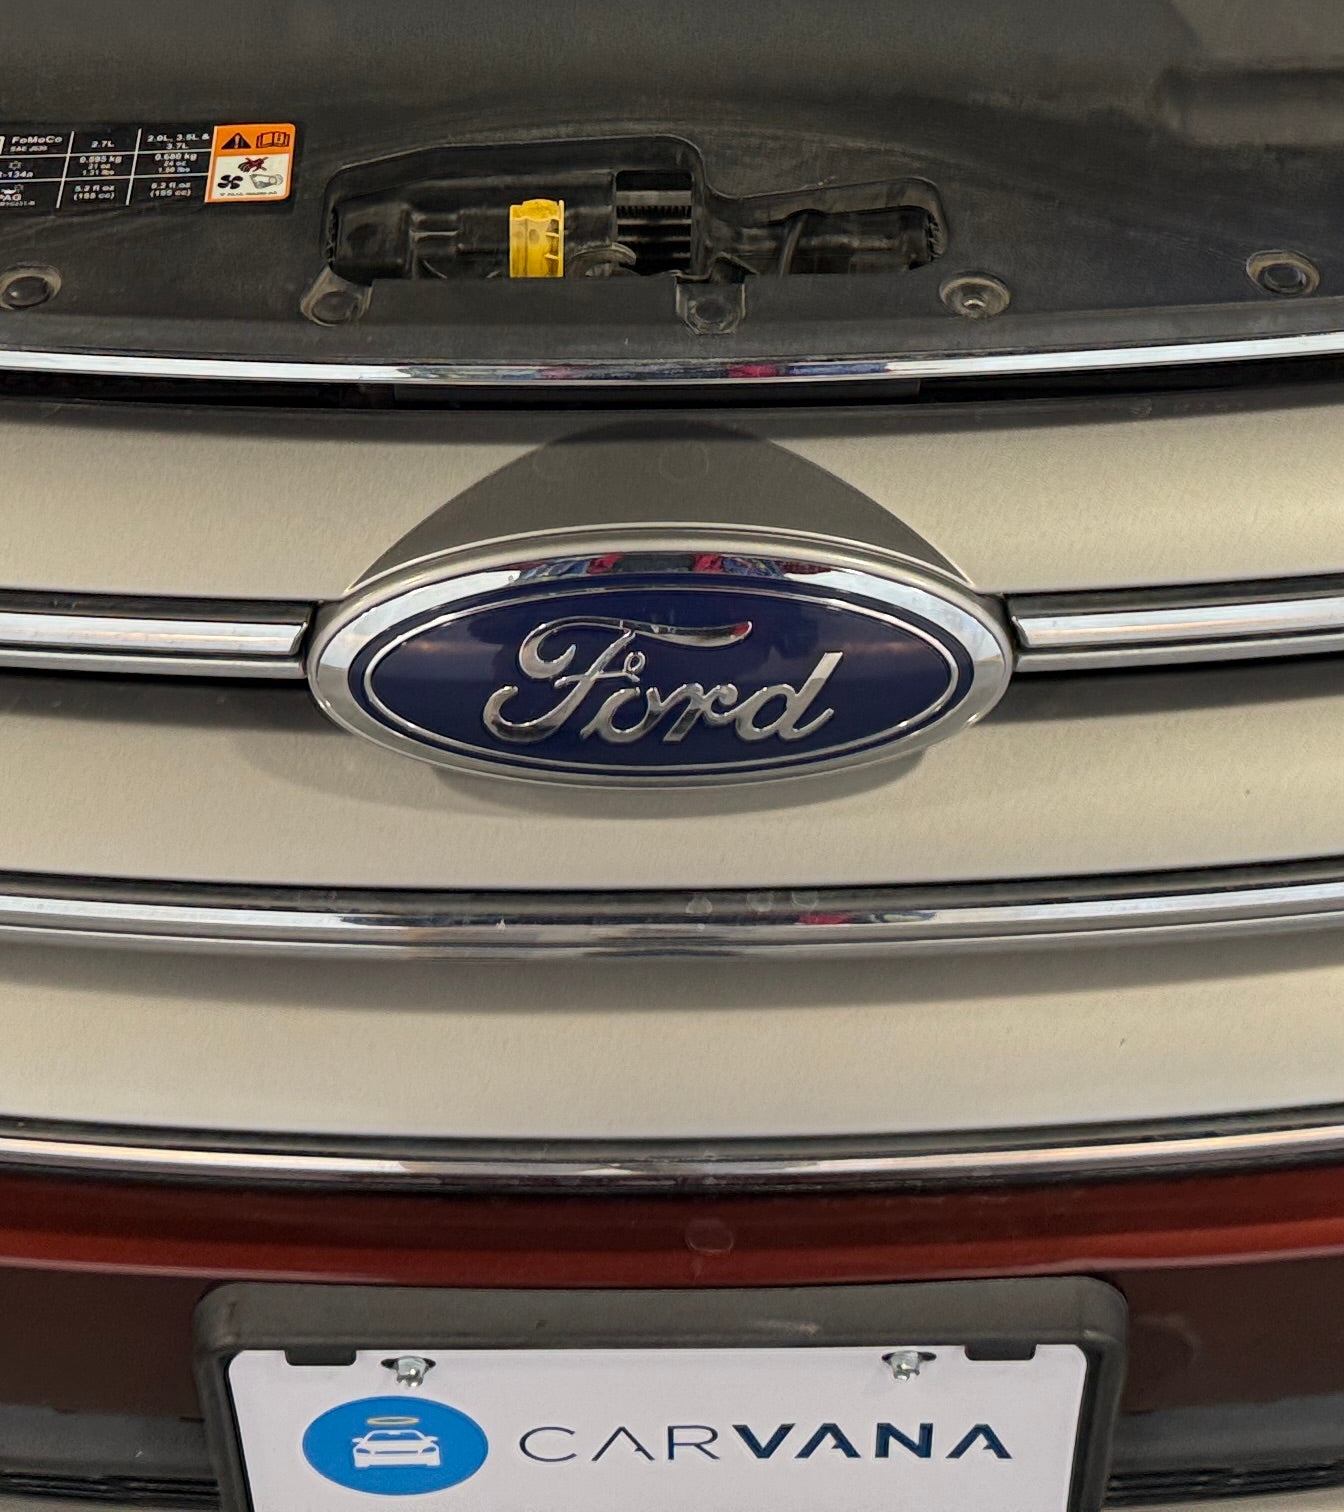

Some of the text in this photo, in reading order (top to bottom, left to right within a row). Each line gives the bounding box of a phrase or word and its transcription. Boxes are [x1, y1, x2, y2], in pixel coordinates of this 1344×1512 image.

[11, 135, 63, 144] FoMoCo
[202, 132, 210, 140] &
[109, 155, 122, 164] kg
[184, 153, 198, 161] kg
[482, 615, 845, 745] Ford
[519, 1422, 1014, 1464] CARVANA
